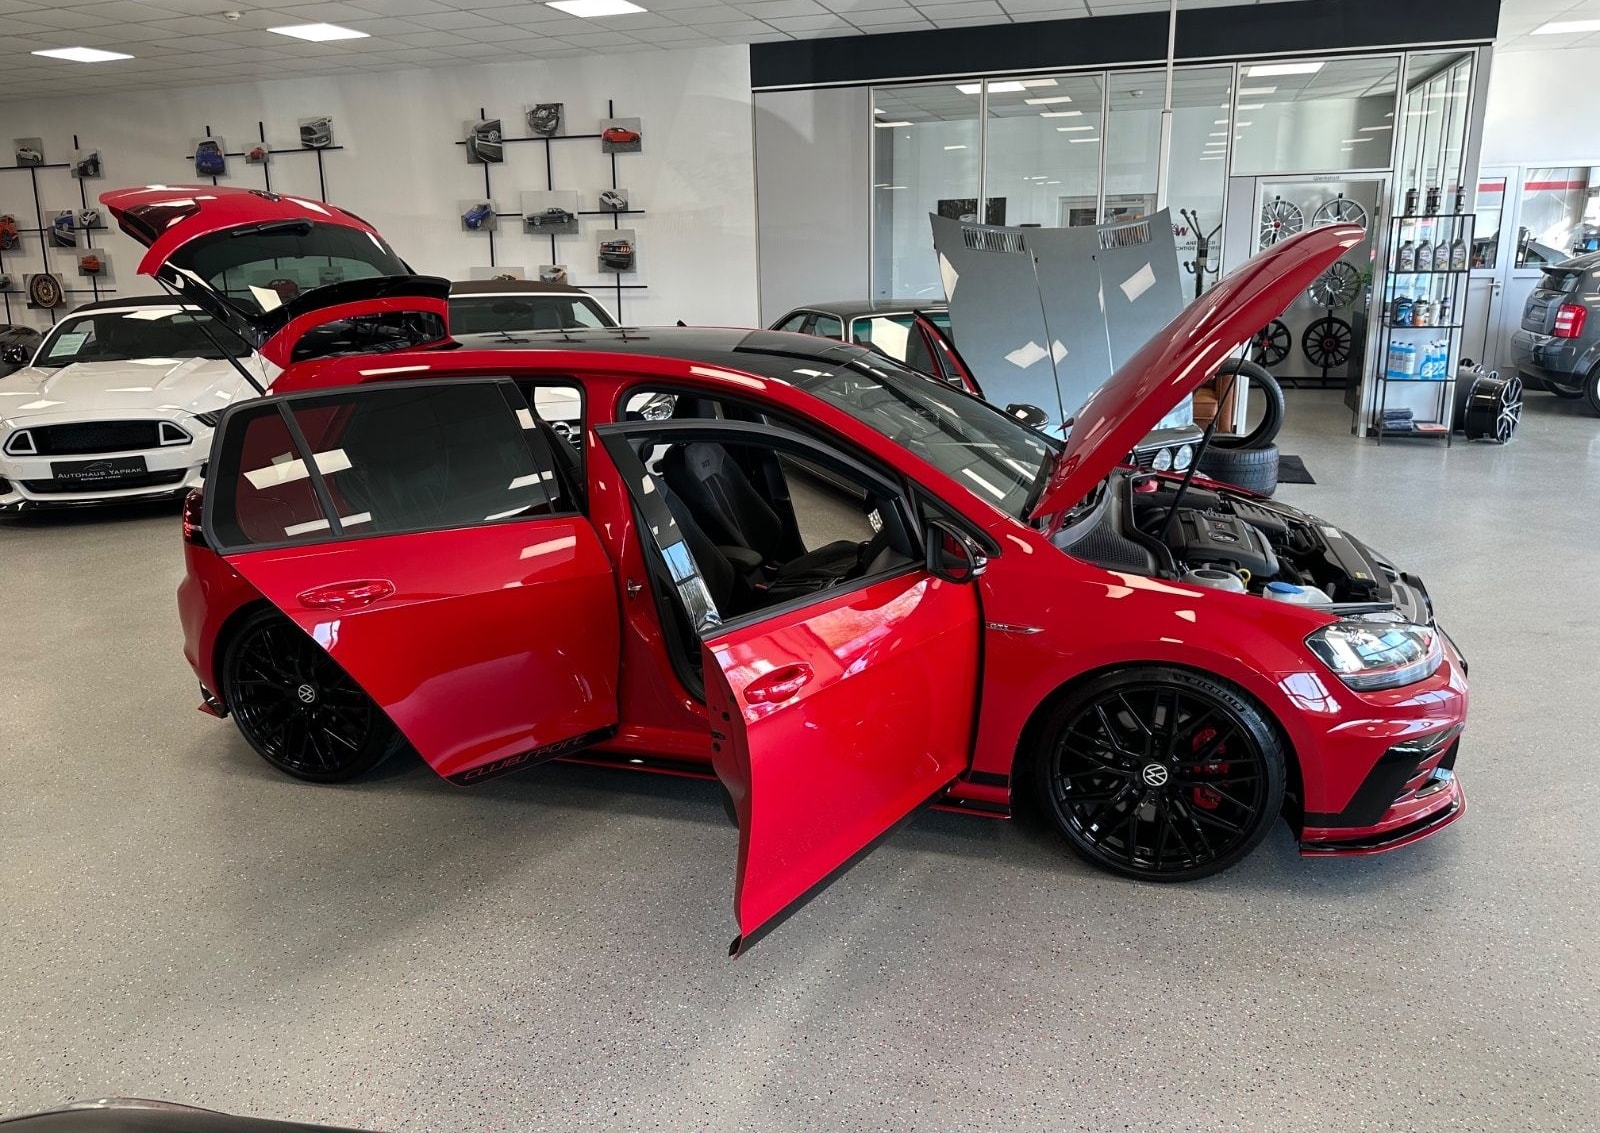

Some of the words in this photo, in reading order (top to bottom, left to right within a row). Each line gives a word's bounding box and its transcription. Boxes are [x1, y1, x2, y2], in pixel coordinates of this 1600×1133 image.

[57, 471, 106, 479] AUTOHAUS
[109, 467, 142, 475] YAPRAK
[1187, 675, 1246, 713] MICHELIN
